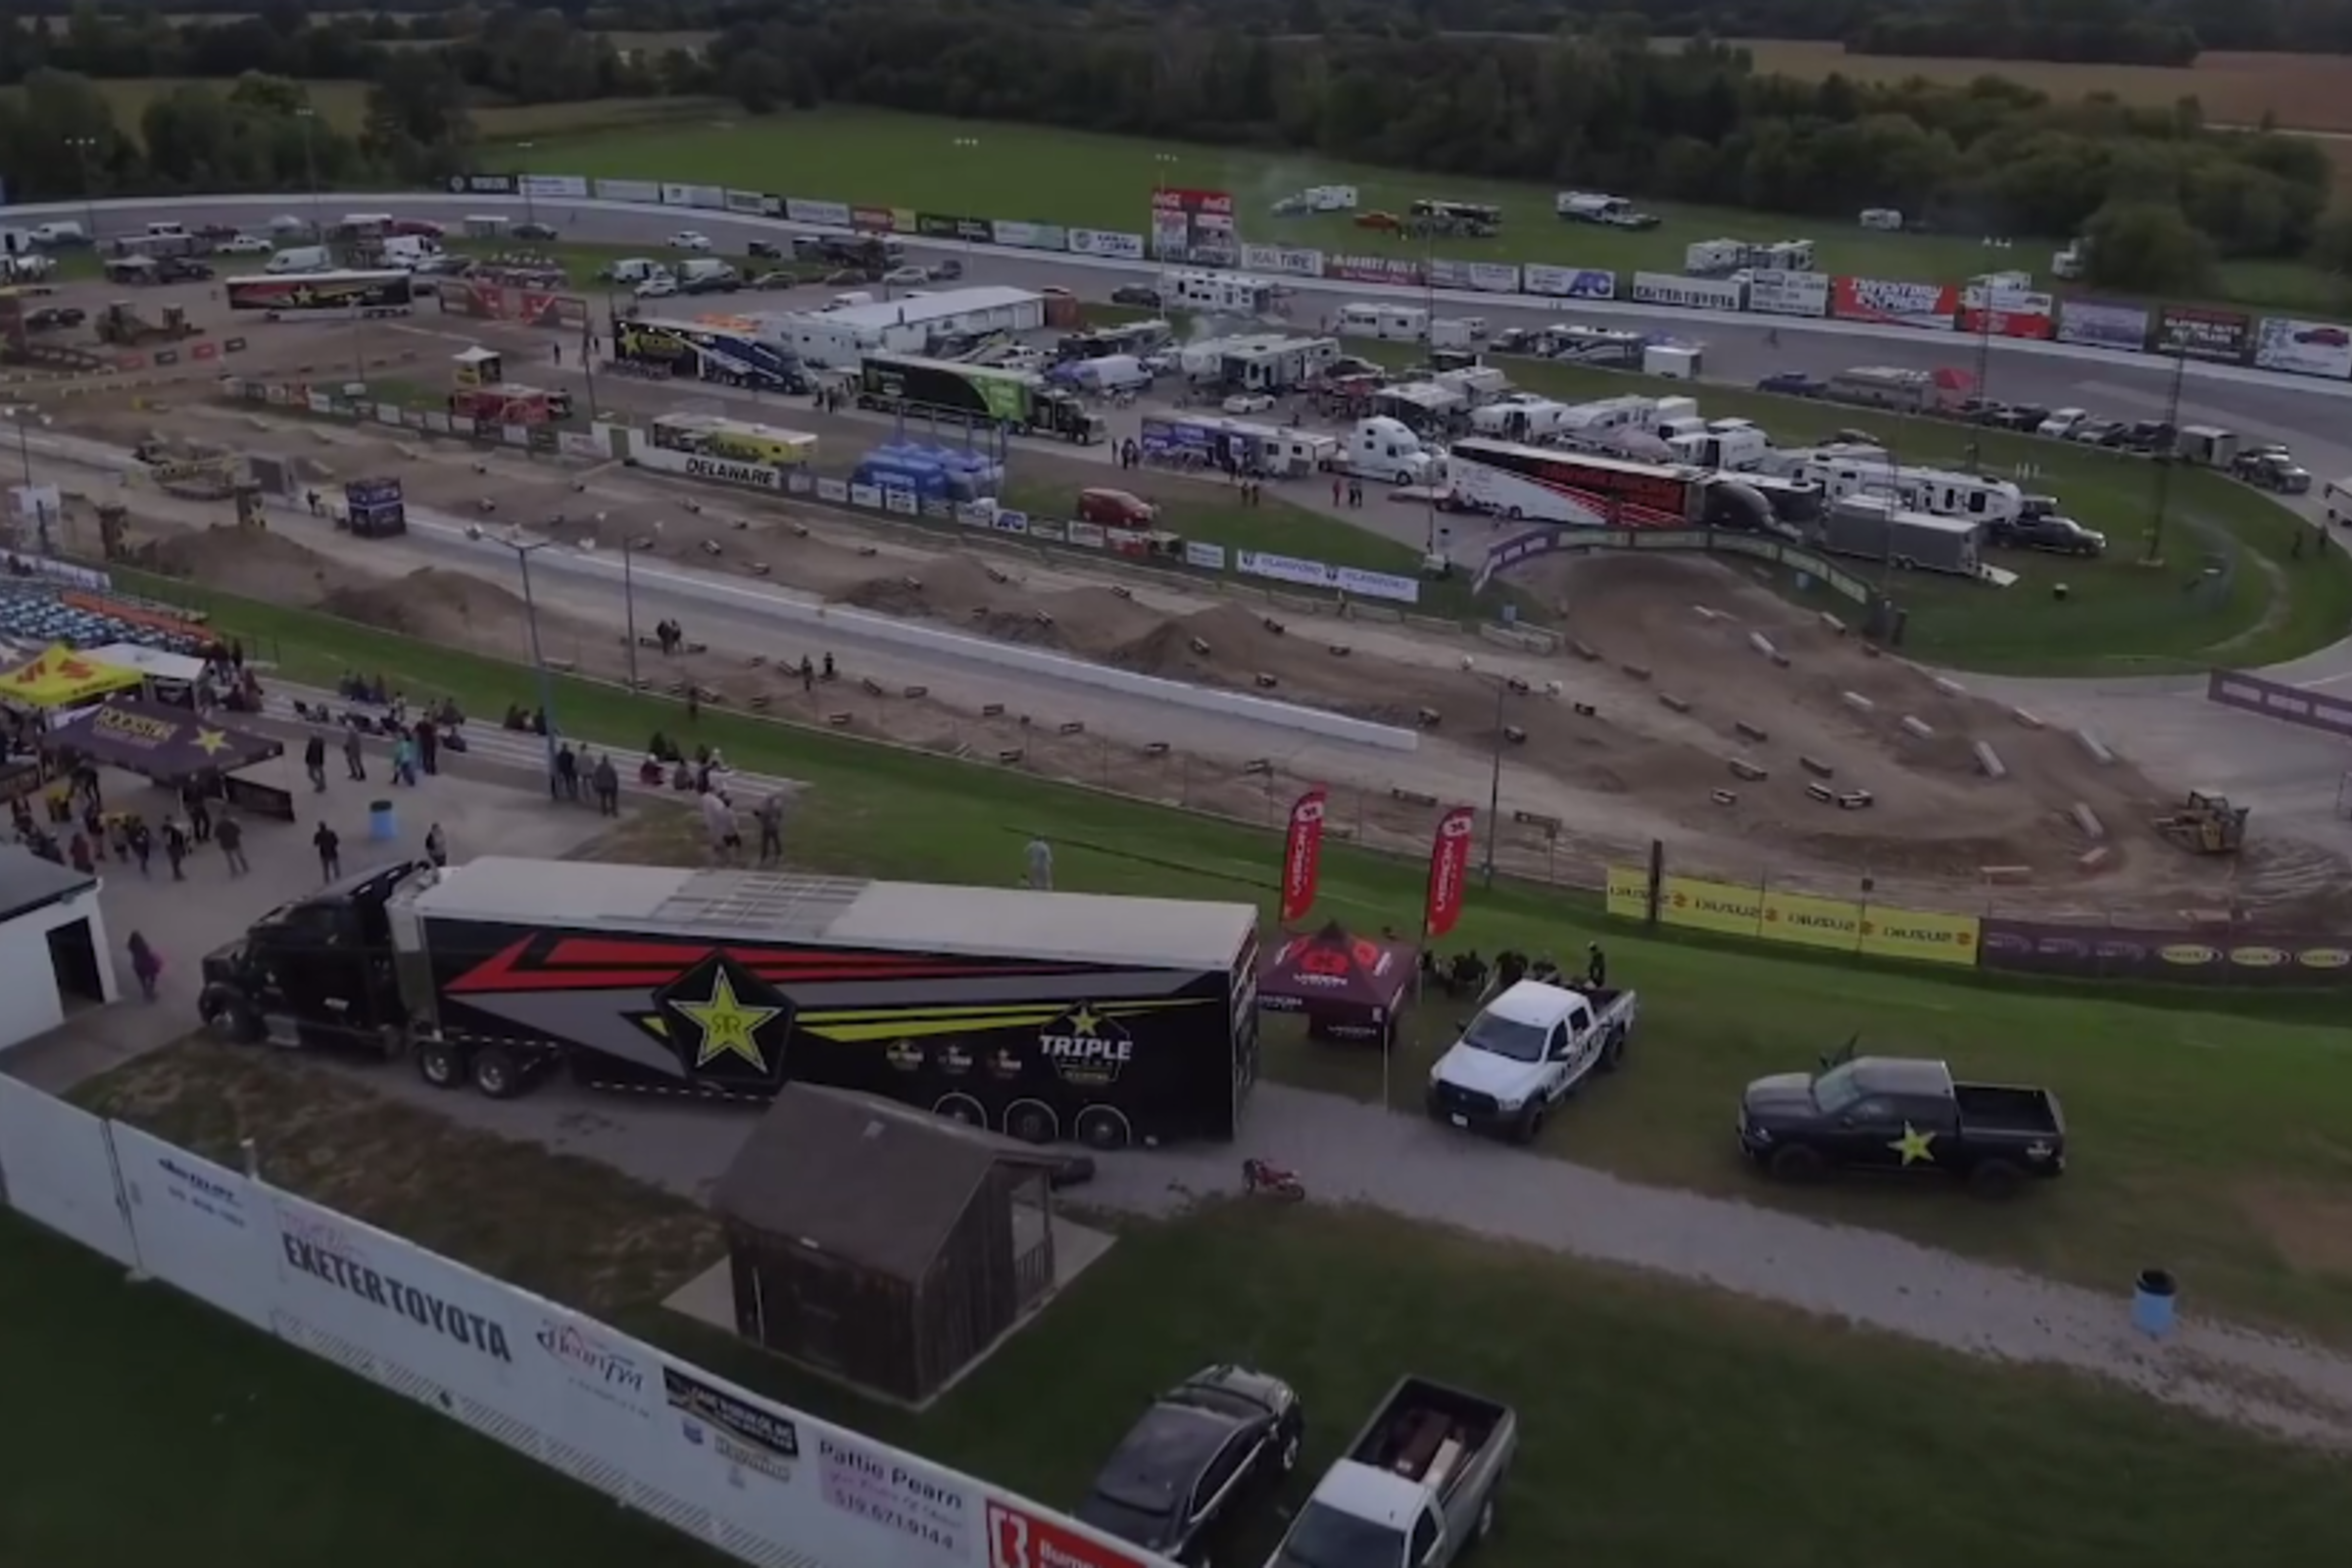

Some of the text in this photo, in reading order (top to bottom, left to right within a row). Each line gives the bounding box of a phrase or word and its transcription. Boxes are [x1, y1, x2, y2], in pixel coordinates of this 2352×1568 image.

[685, 458, 775, 484] DELAWARE
[1038, 1034, 1134, 1060] TRIPLE
[281, 1232, 513, 1363] EXETER TOYOTA
[819, 1440, 884, 1480] Pattie
[892, 1467, 962, 1510] Pearn
